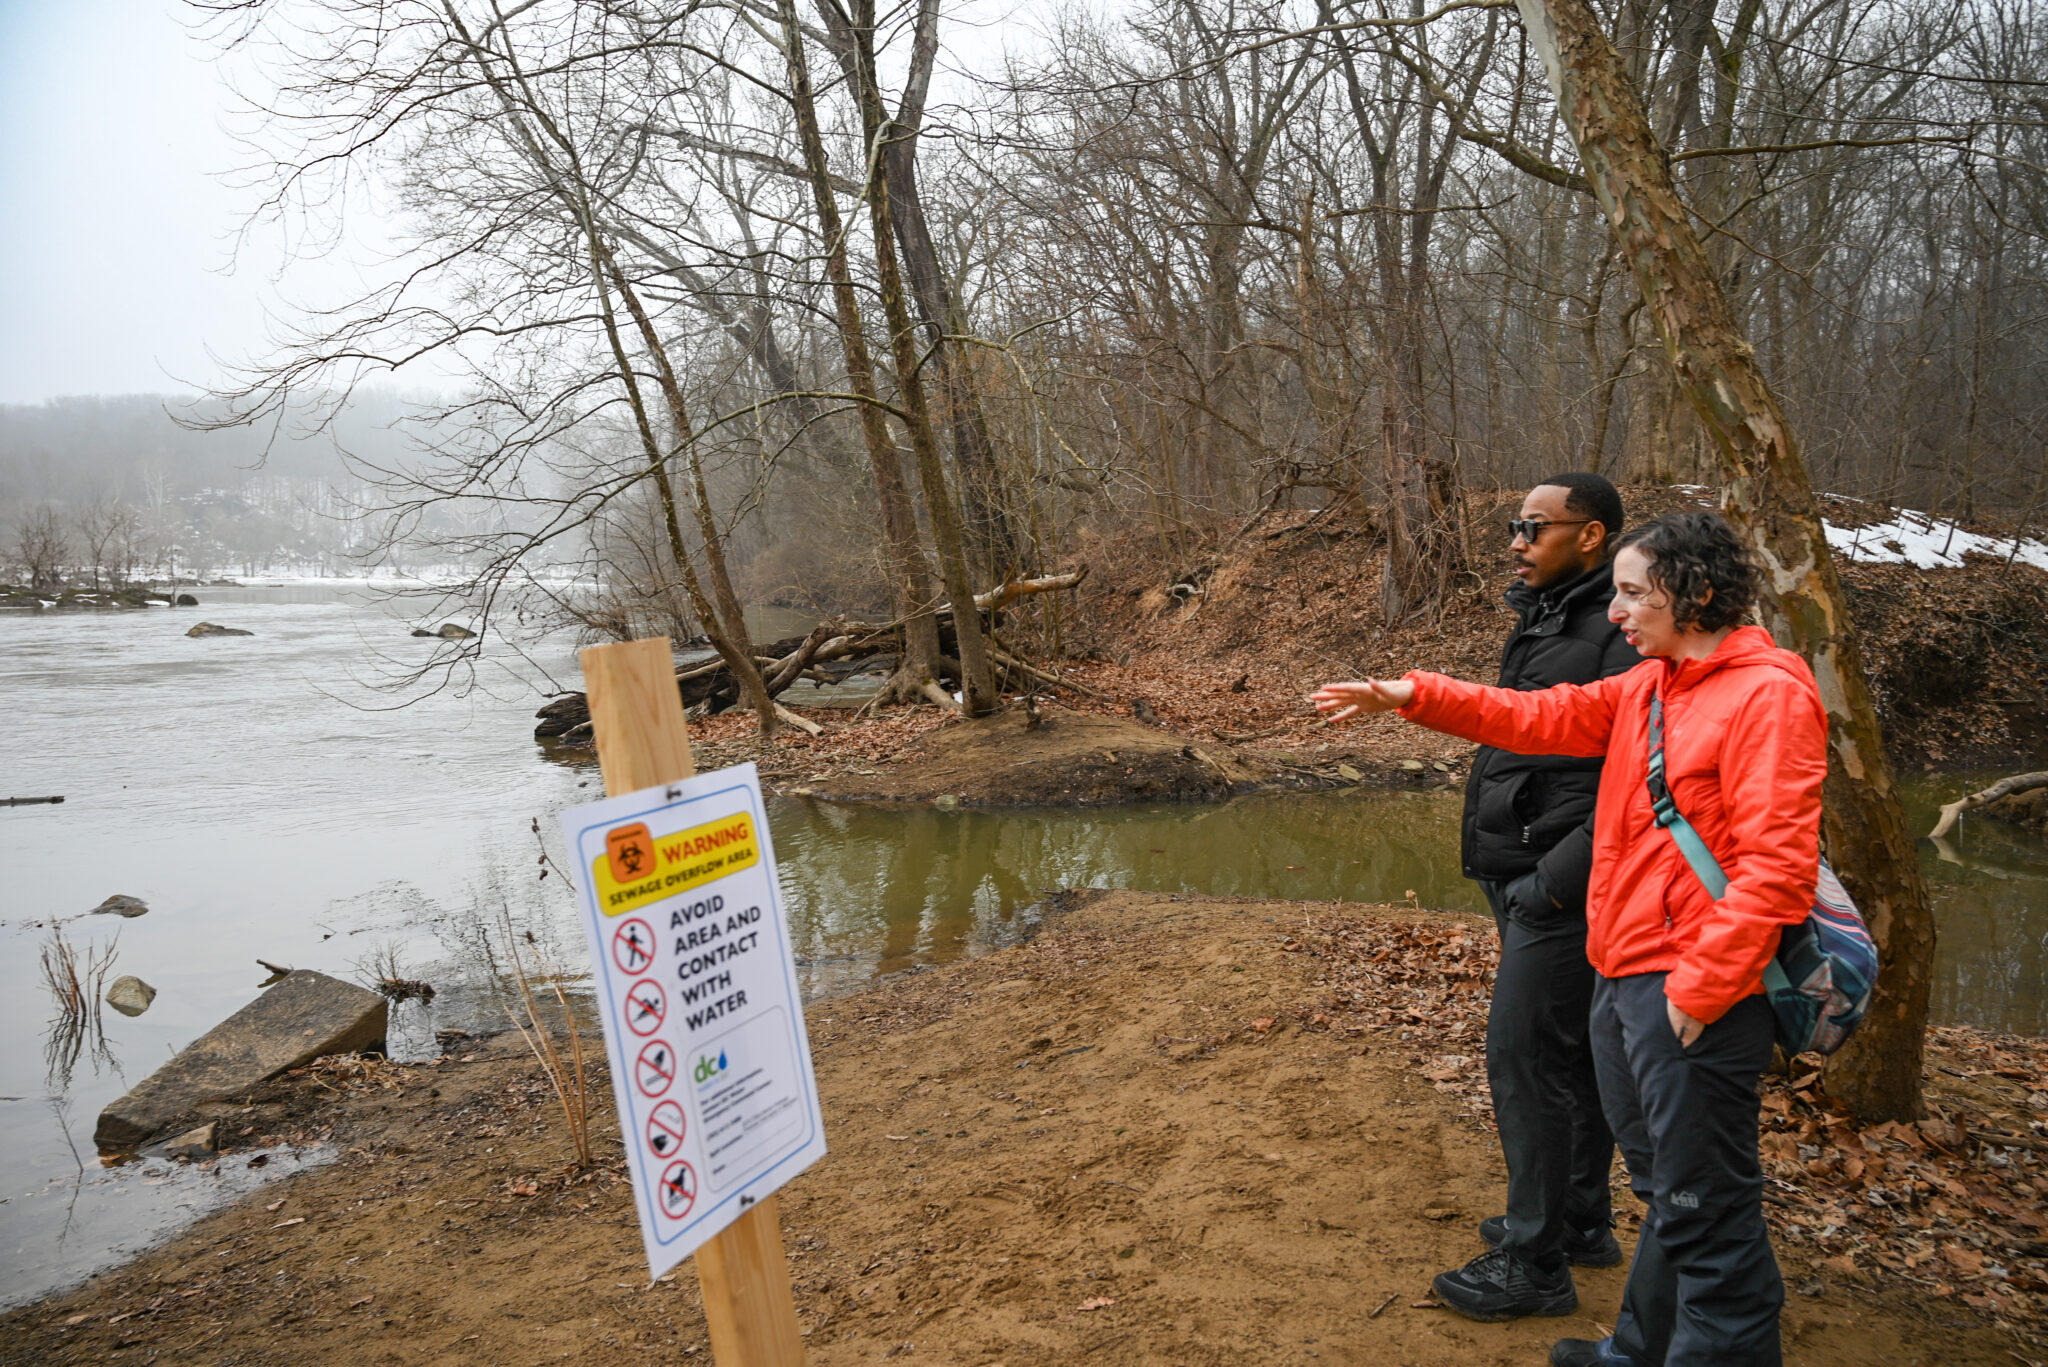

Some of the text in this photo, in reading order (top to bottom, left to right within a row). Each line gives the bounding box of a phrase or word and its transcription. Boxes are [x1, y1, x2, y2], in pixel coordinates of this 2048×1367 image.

[662, 822, 748, 864] WARNING
[609, 848, 753, 907] SEWAGE OVERFLOW AREA
[670, 895, 724, 930] AVOID
[674, 905, 761, 956] AREA AND
[678, 931, 758, 980] CONTACT
[681, 970, 732, 1006] WITH
[685, 990, 748, 1031] WATER
[694, 1054, 719, 1083] dc
